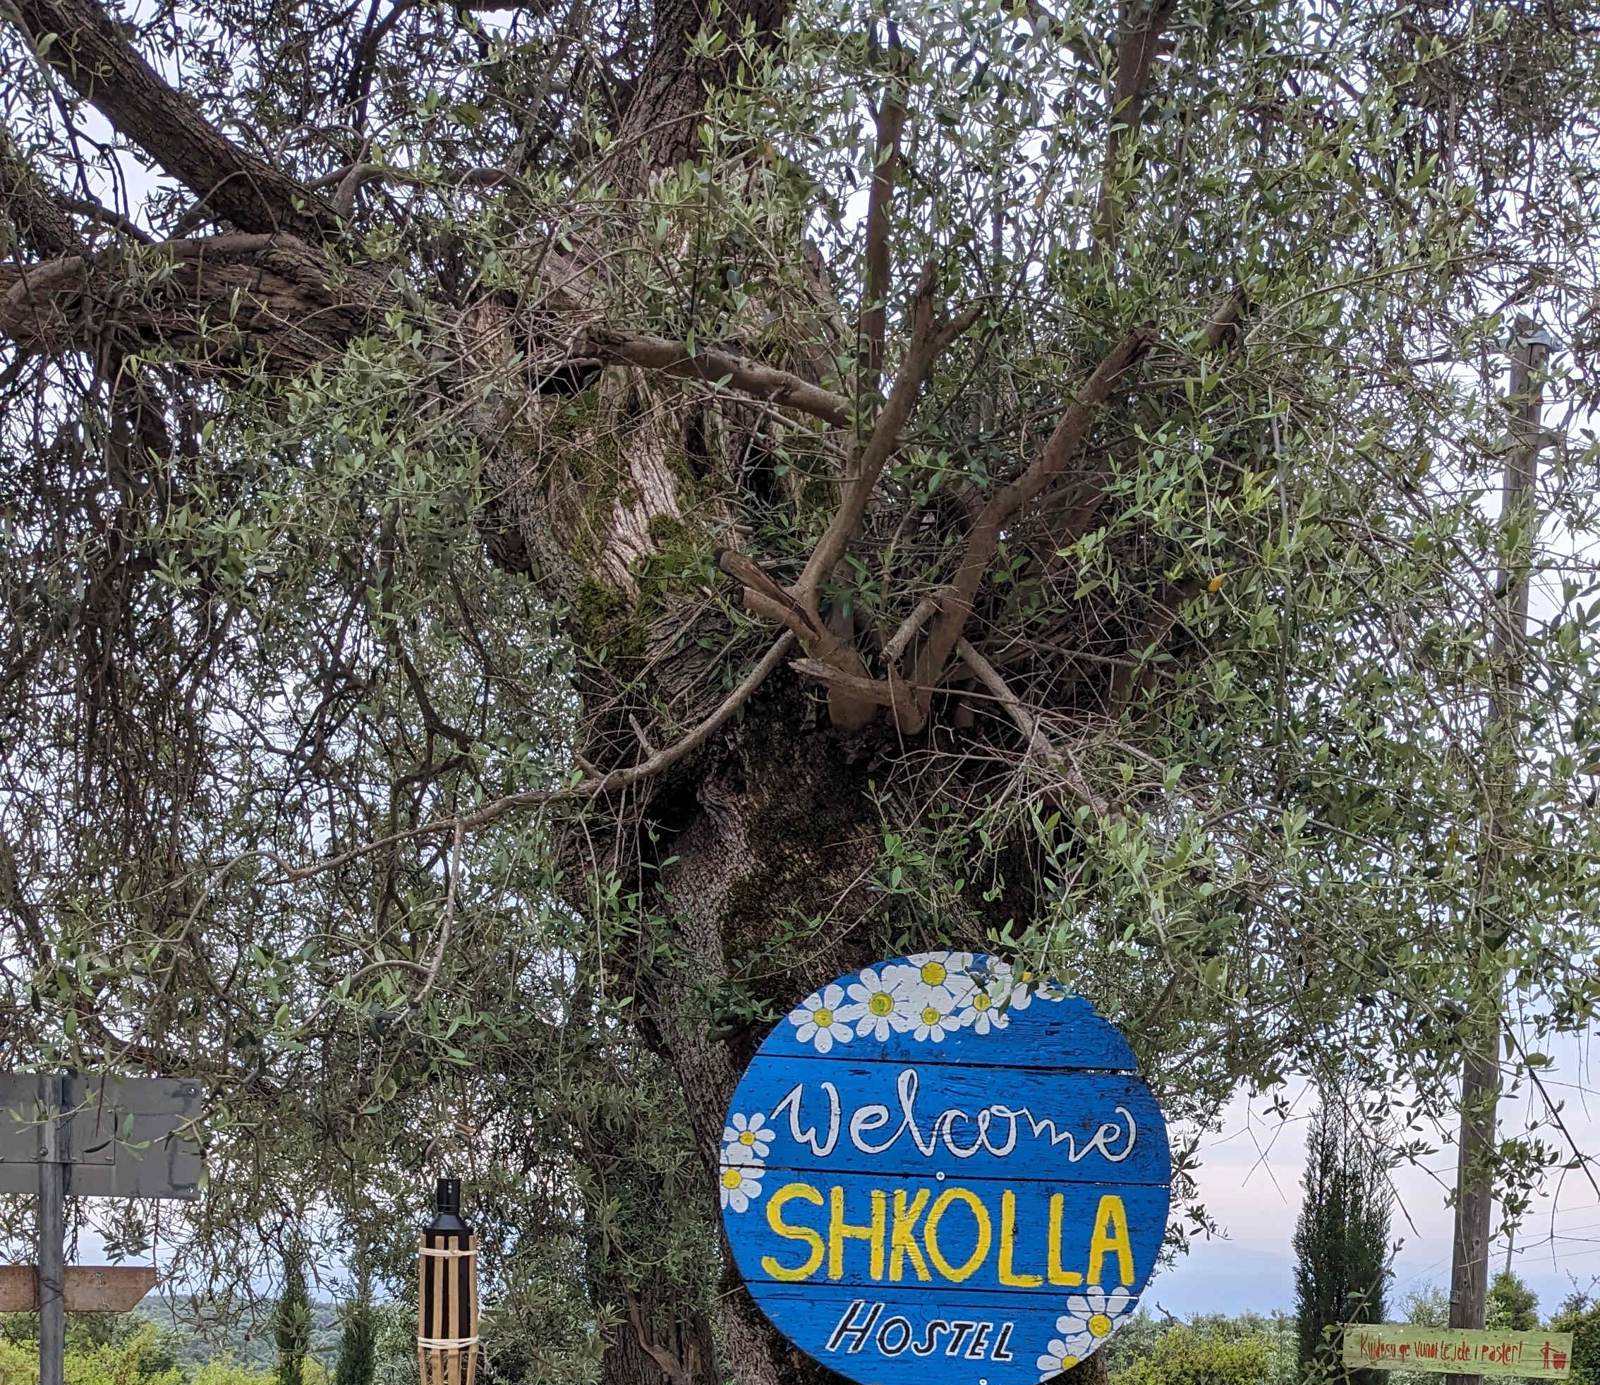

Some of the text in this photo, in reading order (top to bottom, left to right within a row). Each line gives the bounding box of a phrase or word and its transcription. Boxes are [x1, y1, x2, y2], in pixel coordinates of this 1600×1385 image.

[771, 1070, 1136, 1163] Welcome
[761, 1183, 1134, 1287] SHKOLLA
[826, 1299, 1014, 1362] HOSTEL
